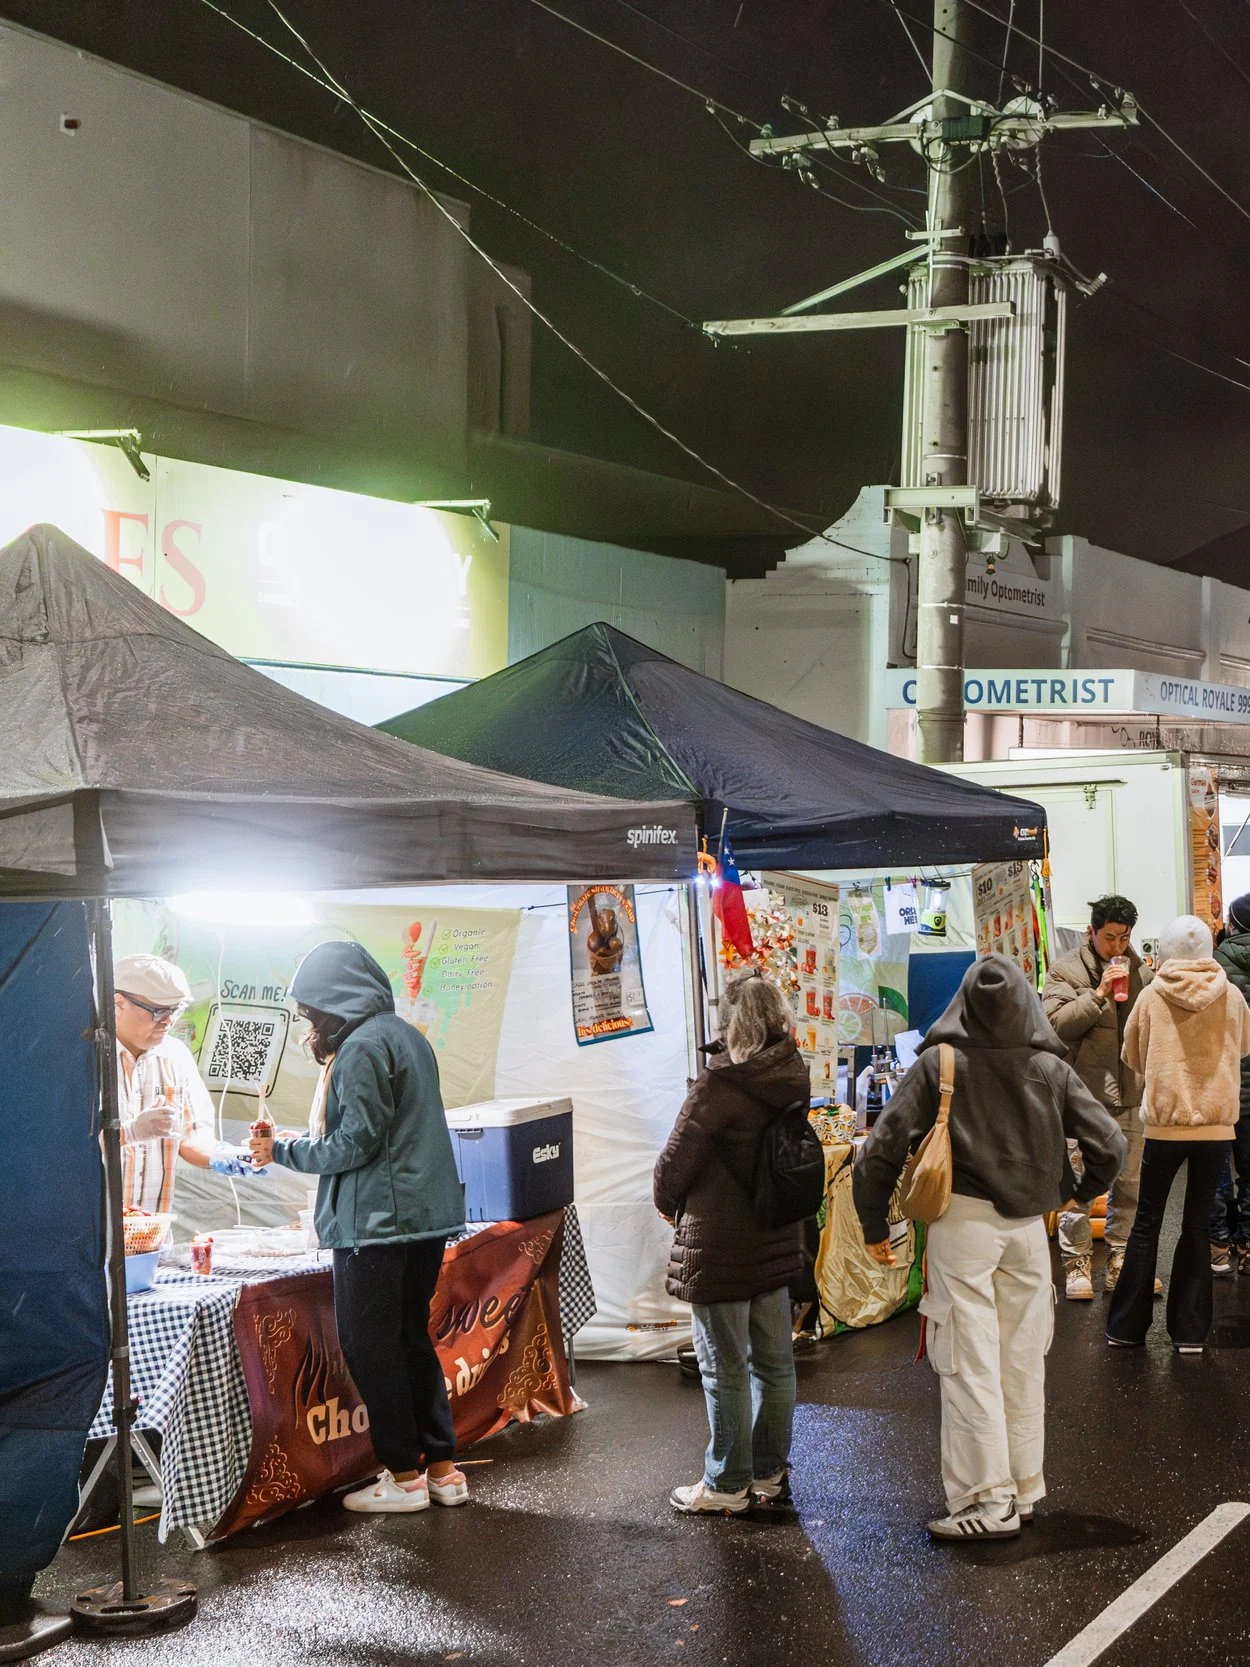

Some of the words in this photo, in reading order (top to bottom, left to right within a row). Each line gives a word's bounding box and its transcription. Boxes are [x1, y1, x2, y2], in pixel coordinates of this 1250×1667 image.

[967, 576, 989, 600] mily
[991, 580, 1046, 607] Optometrist
[902, 678, 1115, 704] OOMETRIST
[1160, 681, 1199, 707] OPTICAL
[1202, 688, 1235, 712] ROYALE
[626, 825, 677, 849] spinifex
[977, 877, 993, 896] $10
[812, 902, 829, 917] $13
[452, 929, 486, 938] Organic
[441, 956, 467, 965] Gluten
[262, 985, 288, 1002] ME!
[440, 983, 465, 992] Honey
